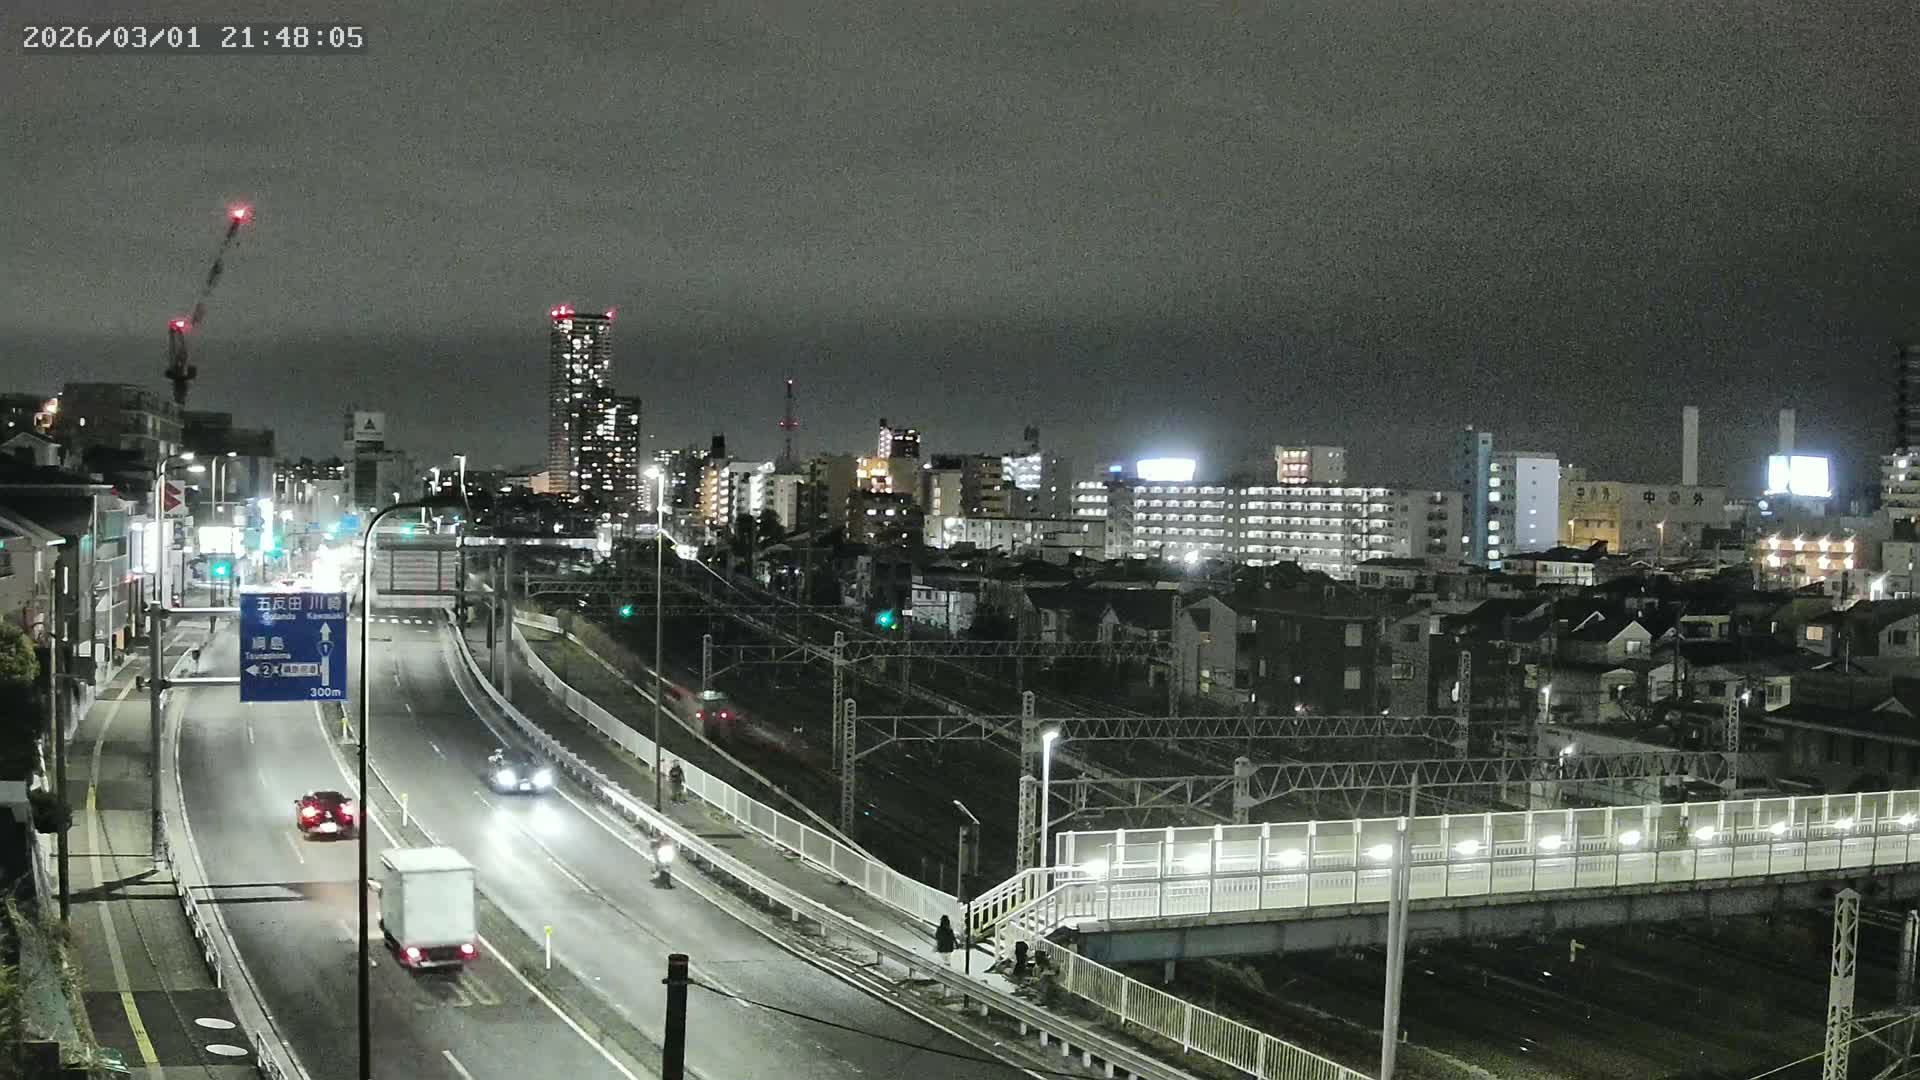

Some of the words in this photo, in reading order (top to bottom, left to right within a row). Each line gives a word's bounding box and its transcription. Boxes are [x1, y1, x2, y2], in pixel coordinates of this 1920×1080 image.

[257, 597, 302, 611] 五反田
[310, 688, 341, 697] 300m
